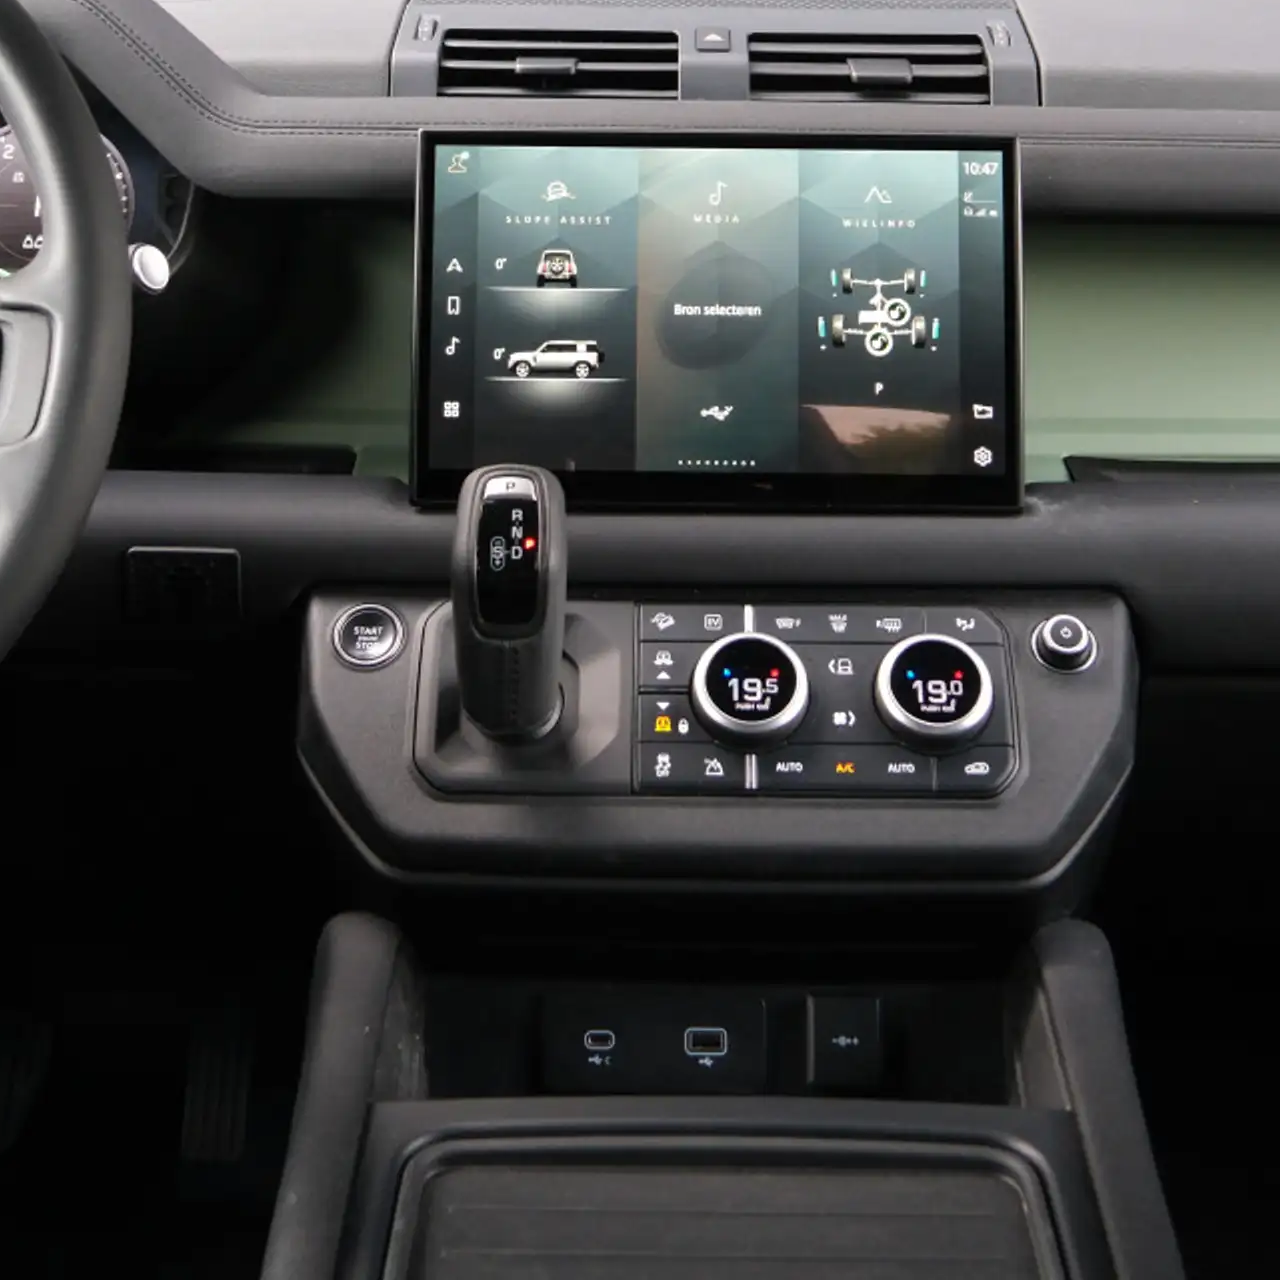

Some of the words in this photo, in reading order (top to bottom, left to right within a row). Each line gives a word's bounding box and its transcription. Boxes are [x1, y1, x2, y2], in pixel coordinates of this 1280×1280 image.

[2, 144, 15, 160] 2
[962, 161, 999, 176] 10:47
[505, 215, 551, 225] SLOPE
[559, 215, 611, 225] ASSIST
[693, 213, 741, 224] MEDIA
[673, 304, 701, 316] Bron
[703, 304, 762, 317] selecteren
[875, 382, 884, 395] P
[511, 508, 524, 522] R
[511, 525, 524, 539] N
[511, 545, 523, 560] D
[353, 626, 383, 636] START
[728, 677, 779, 702] 19.5
[912, 680, 963, 704] 19.0
[776, 761, 803, 773] AUTO
[835, 763, 855, 774] A/C
[888, 763, 915, 773] AUTO
